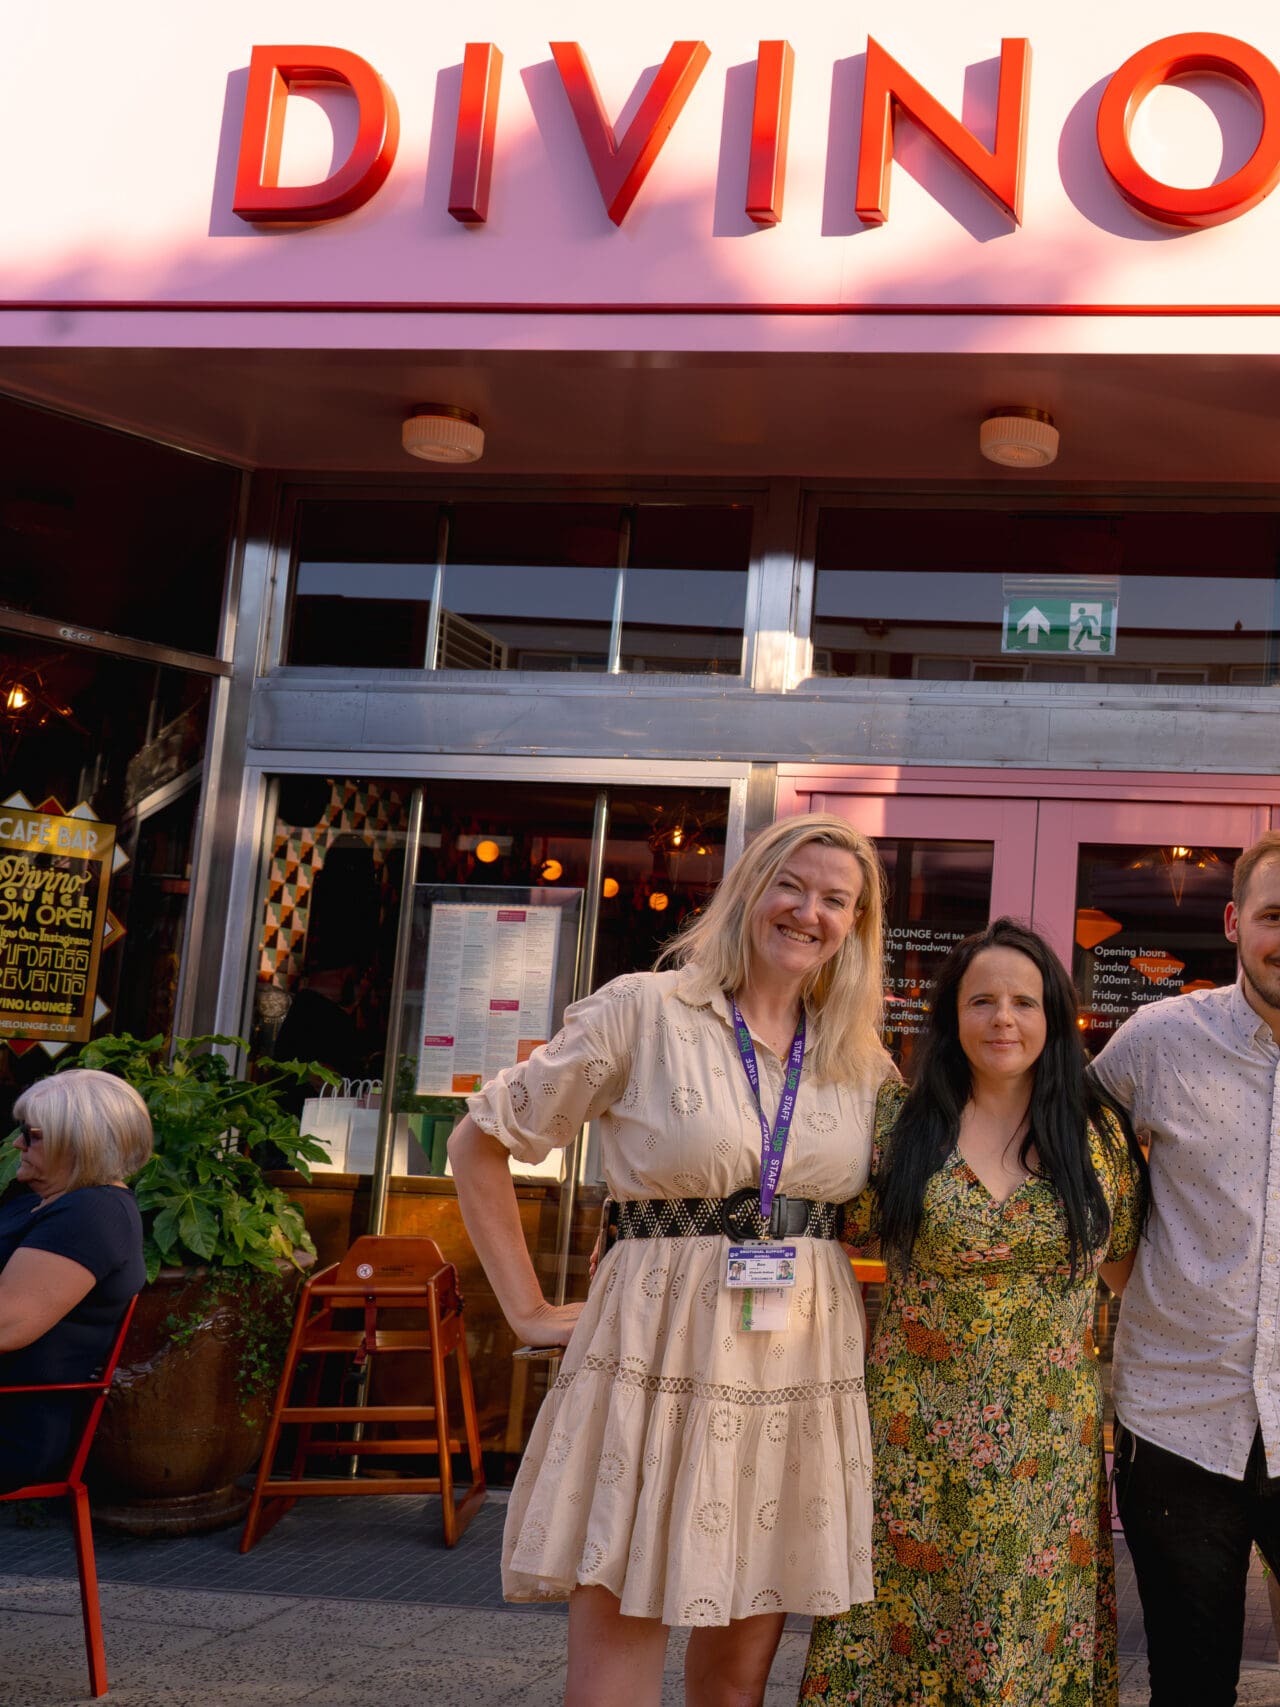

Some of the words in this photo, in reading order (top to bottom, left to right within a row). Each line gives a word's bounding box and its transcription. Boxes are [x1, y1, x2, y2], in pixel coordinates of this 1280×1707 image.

[0, 817, 51, 846] CAFÉ
[57, 825, 98, 853] BAR
[3, 887, 90, 909] OUNGE
[0, 900, 29, 923] OW
[35, 905, 93, 930] OPEN
[889, 928, 933, 939] LOUNGE
[886, 940, 903, 951] The
[1095, 946, 1137, 958] Opening
[1140, 947, 1167, 958] hours
[1094, 962, 1130, 974] Sunday
[1139, 963, 1183, 976] Thursday
[897, 978, 917, 988] 373
[1093, 974, 1130, 985] 9.00am
[1142, 977, 1185, 988] 11.00pm
[1092, 991, 1122, 1003] Friday
[1131, 992, 1170, 1001] Saturd
[1092, 1003, 1129, 1013] 9.00am
[891, 1011, 924, 1021] coffees
[0, 1020, 77, 1033] HELOUNGES.CO.UK
[1091, 1019, 1113, 1030] (Last
[791, 1040, 804, 1064] STAFF
[780, 1094, 793, 1121] STAFF
[772, 1126, 790, 1153] hugs
[766, 1159, 780, 1190] STAFF
